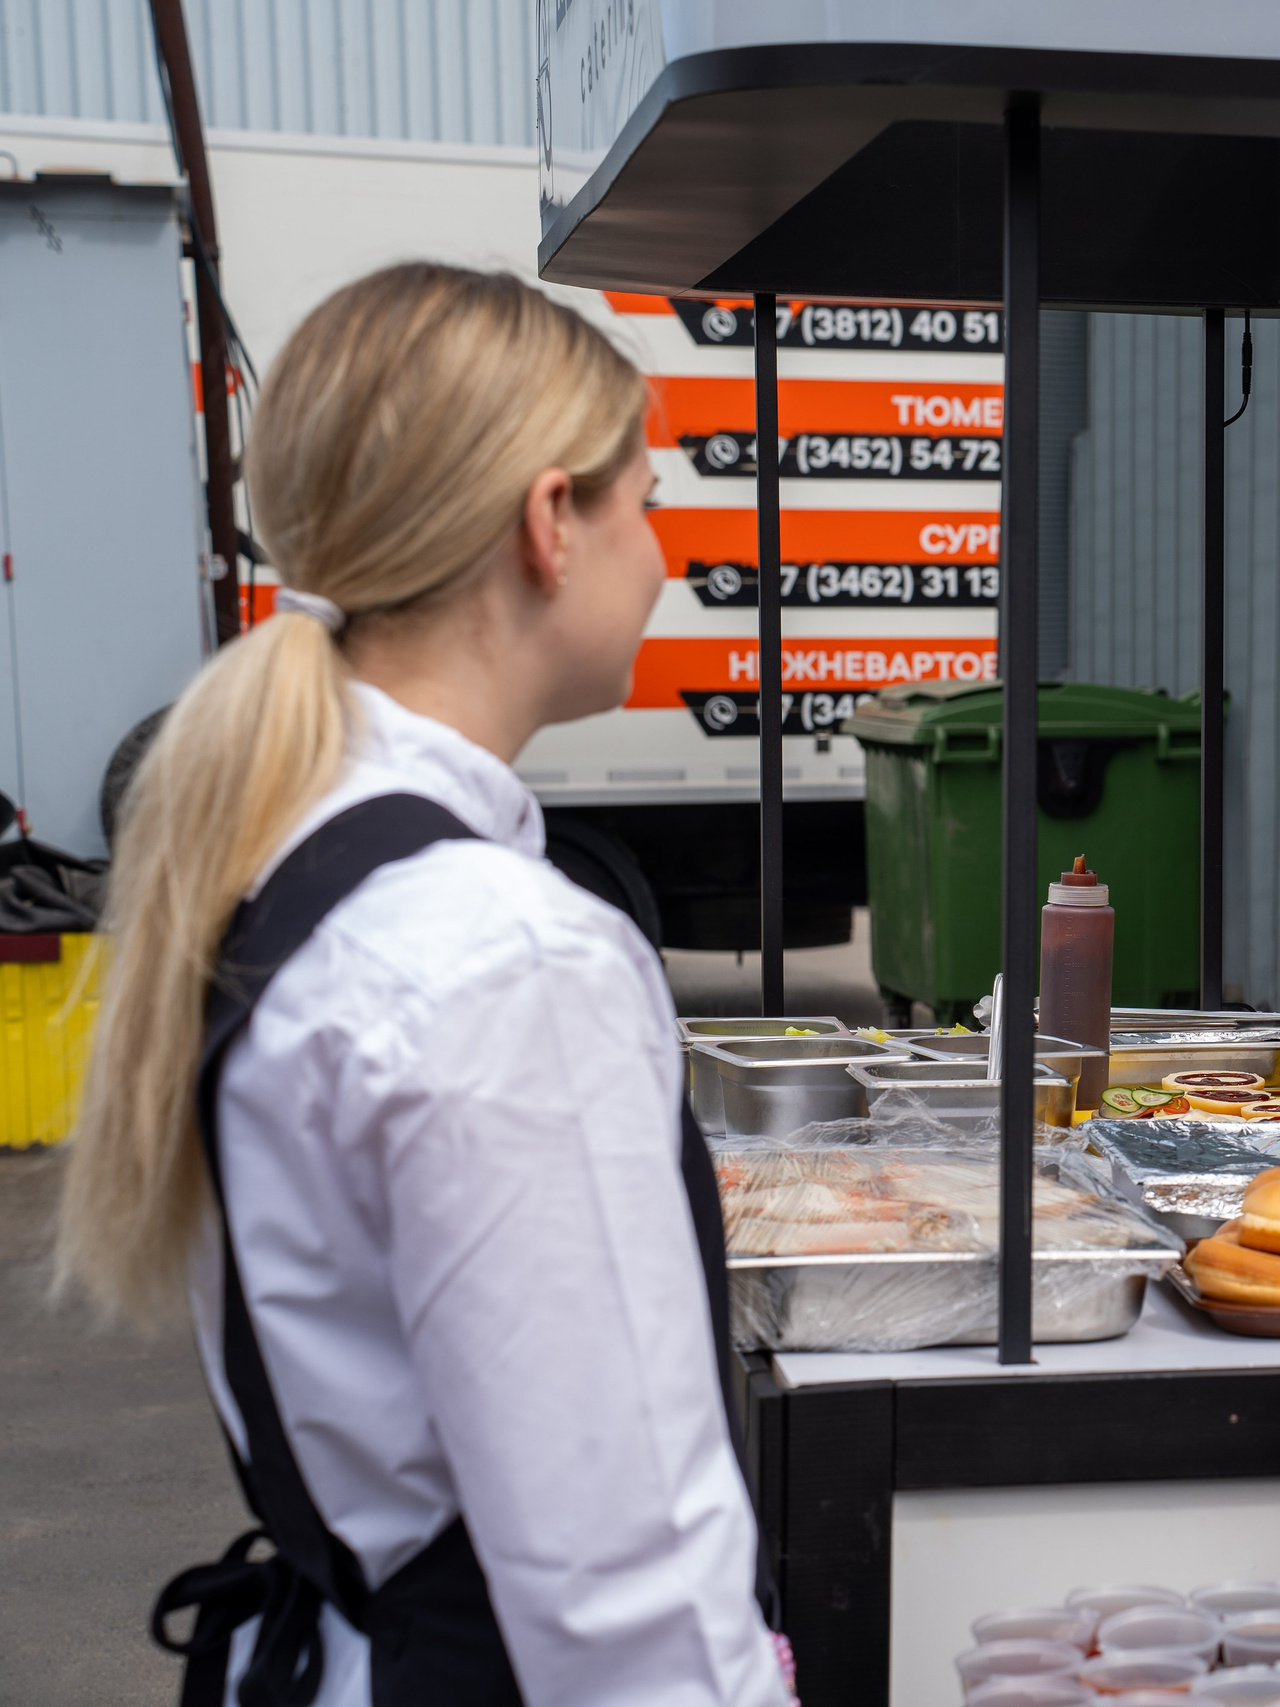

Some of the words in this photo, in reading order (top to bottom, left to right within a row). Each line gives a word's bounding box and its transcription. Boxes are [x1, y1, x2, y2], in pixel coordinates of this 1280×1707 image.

[801, 306, 903, 347] (3812)
[909, 310, 957, 343] 40
[962, 311, 999, 344] 51
[891, 395, 1002, 428] ТЮМЕ
[797, 434, 902, 476] (3452)
[910, 439, 954, 471] 54
[960, 439, 1001, 472] 72
[806, 564, 914, 603] (3462)
[921, 566, 959, 598] 31
[964, 566, 999, 598] 13
[728, 650, 998, 682] НЖНЕВАРТОВ
